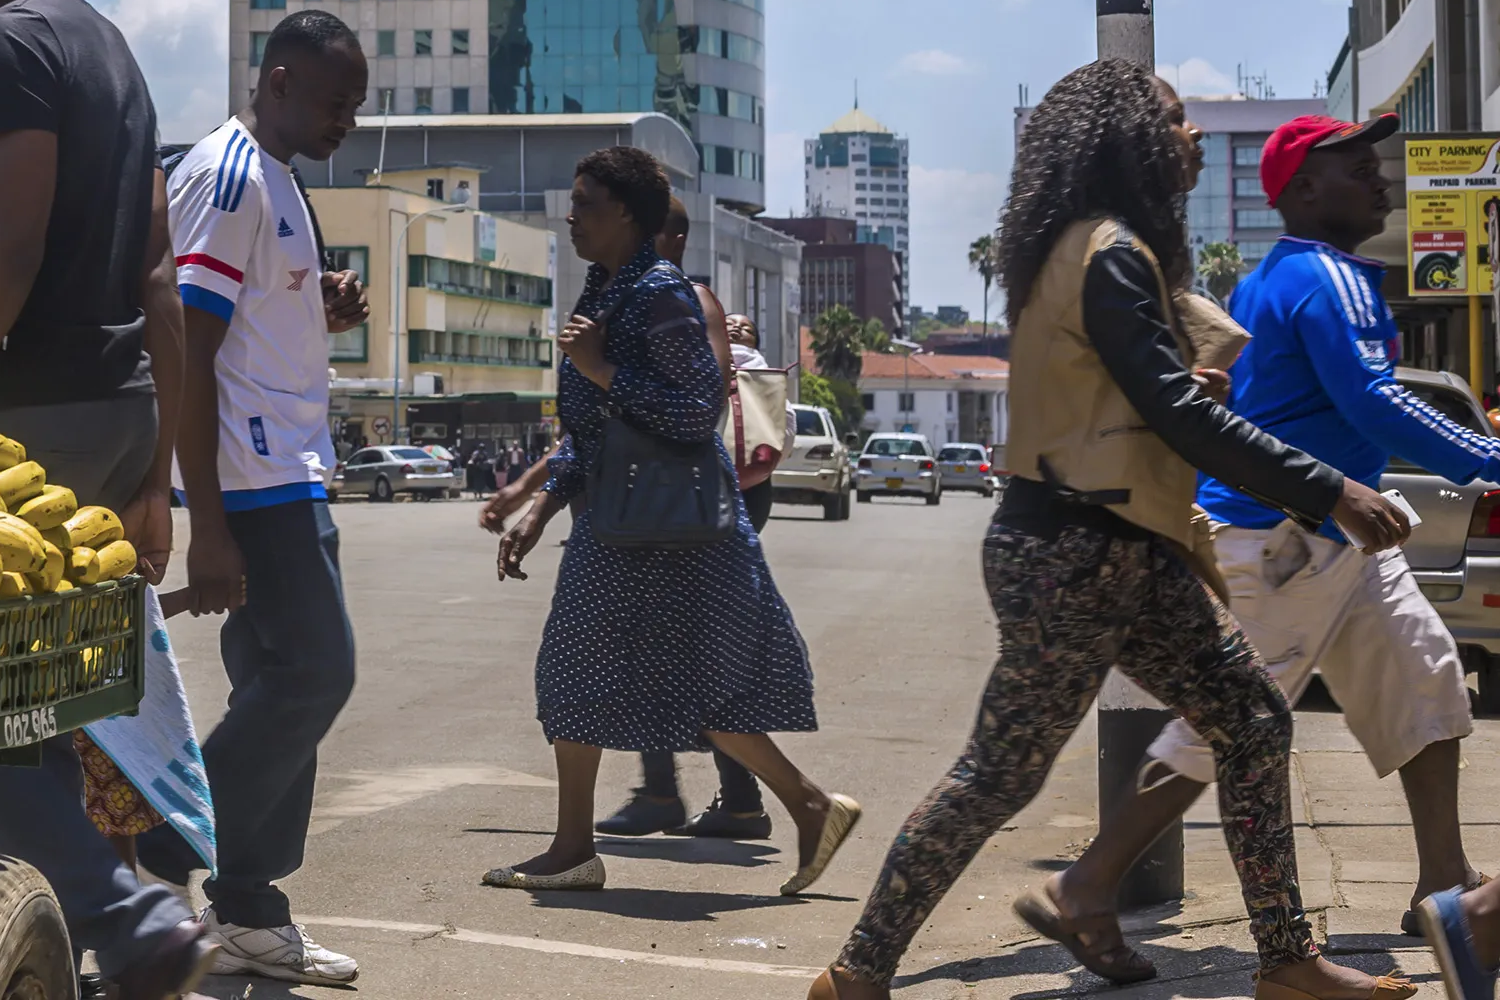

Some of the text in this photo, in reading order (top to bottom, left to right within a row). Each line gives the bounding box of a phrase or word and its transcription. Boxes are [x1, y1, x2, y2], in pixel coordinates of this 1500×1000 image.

[1408, 145, 1487, 157] CITY PARKING
[1429, 177, 1497, 187] PREPAID PARKING
